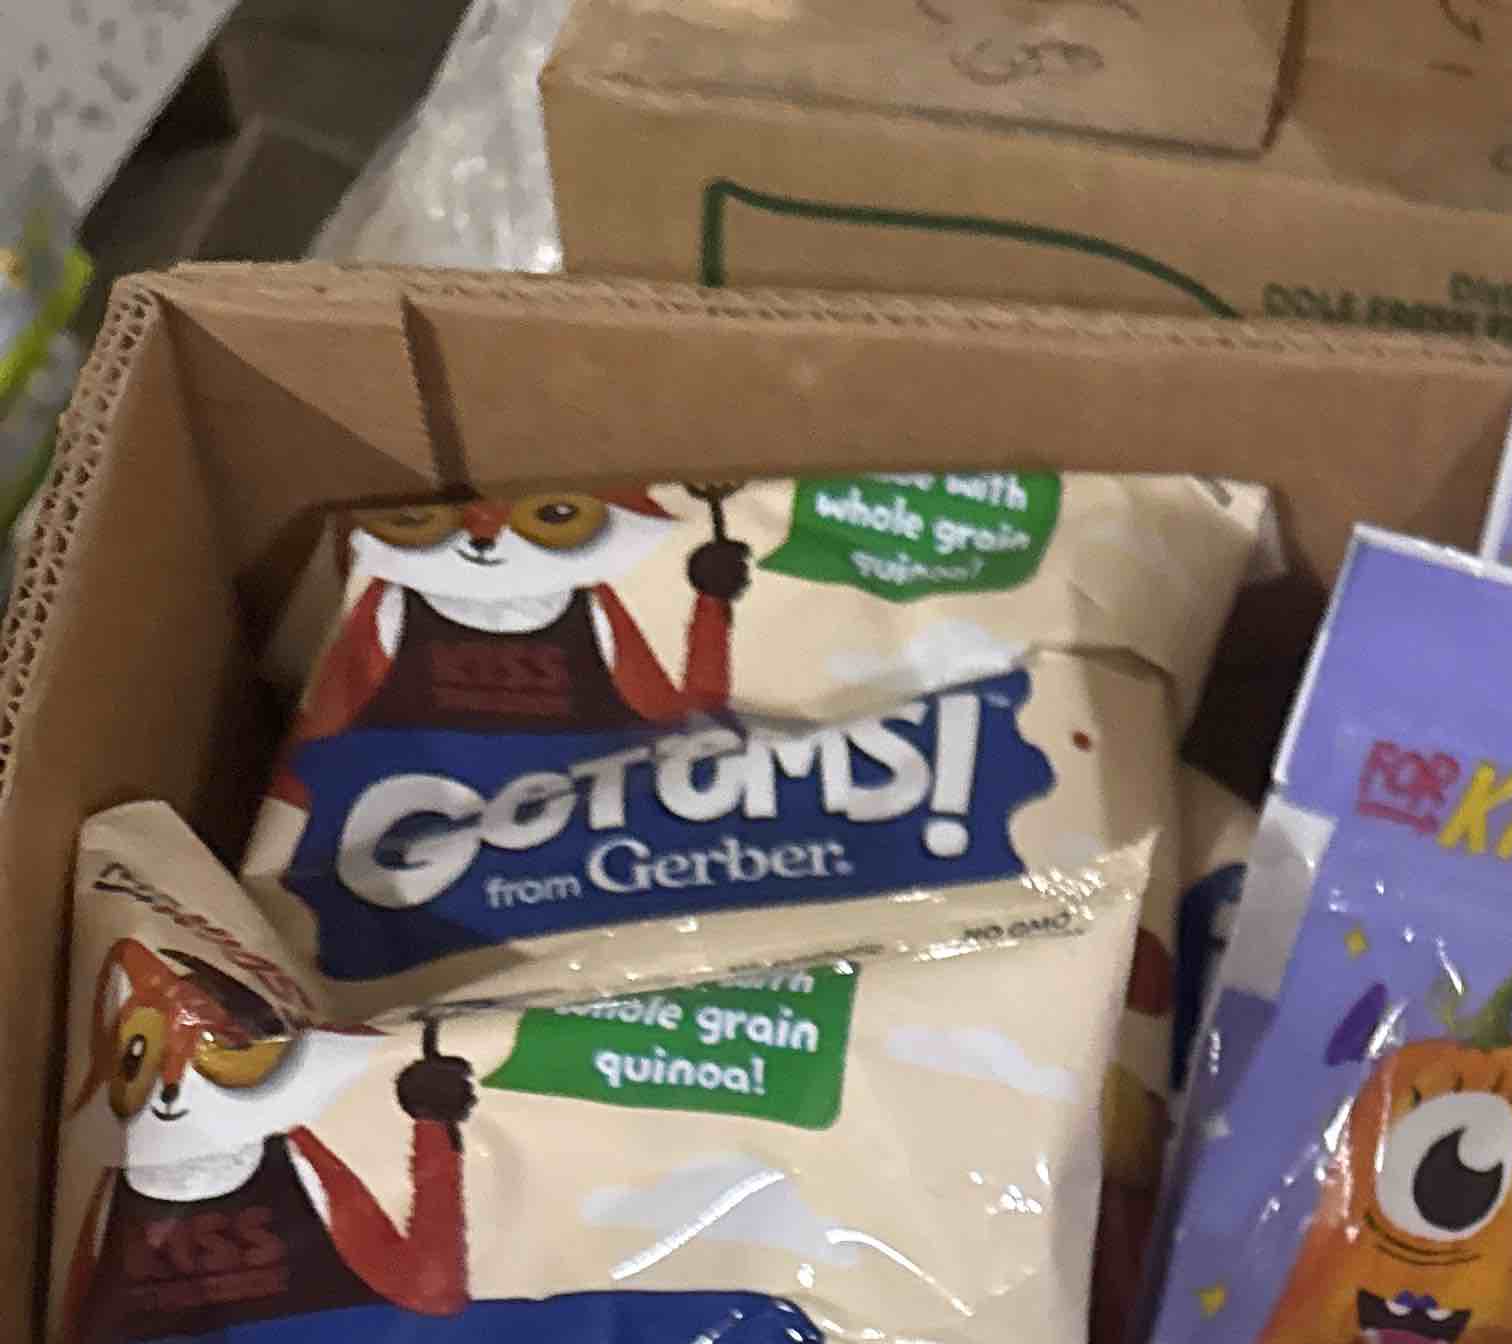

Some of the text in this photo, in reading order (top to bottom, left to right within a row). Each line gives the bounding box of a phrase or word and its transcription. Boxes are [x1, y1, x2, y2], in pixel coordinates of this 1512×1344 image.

[487, 874, 580, 909] from
[695, 1001, 820, 1053] grain
[594, 1047, 766, 1096] quinoa!
